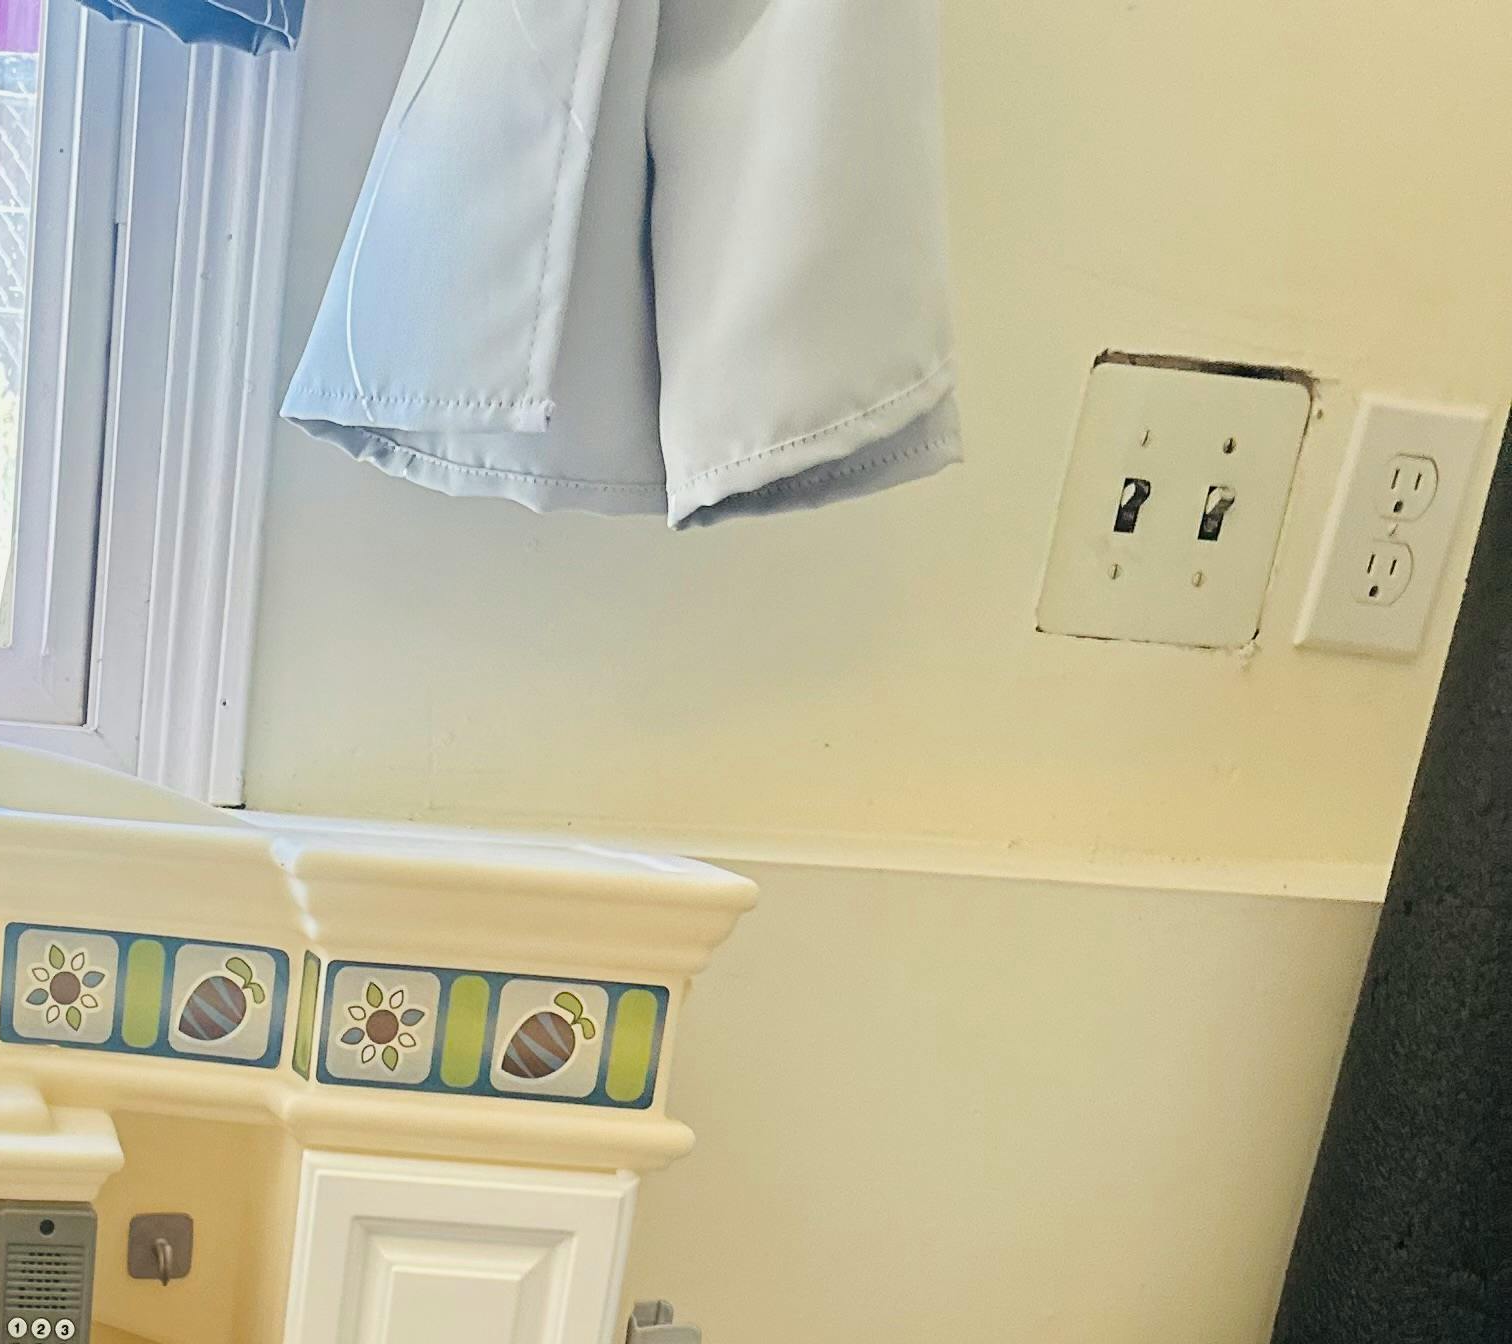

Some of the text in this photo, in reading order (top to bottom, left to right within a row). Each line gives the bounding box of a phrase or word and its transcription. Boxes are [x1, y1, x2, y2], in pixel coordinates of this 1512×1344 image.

[14, 1322, 69, 1336] 1 2 3
